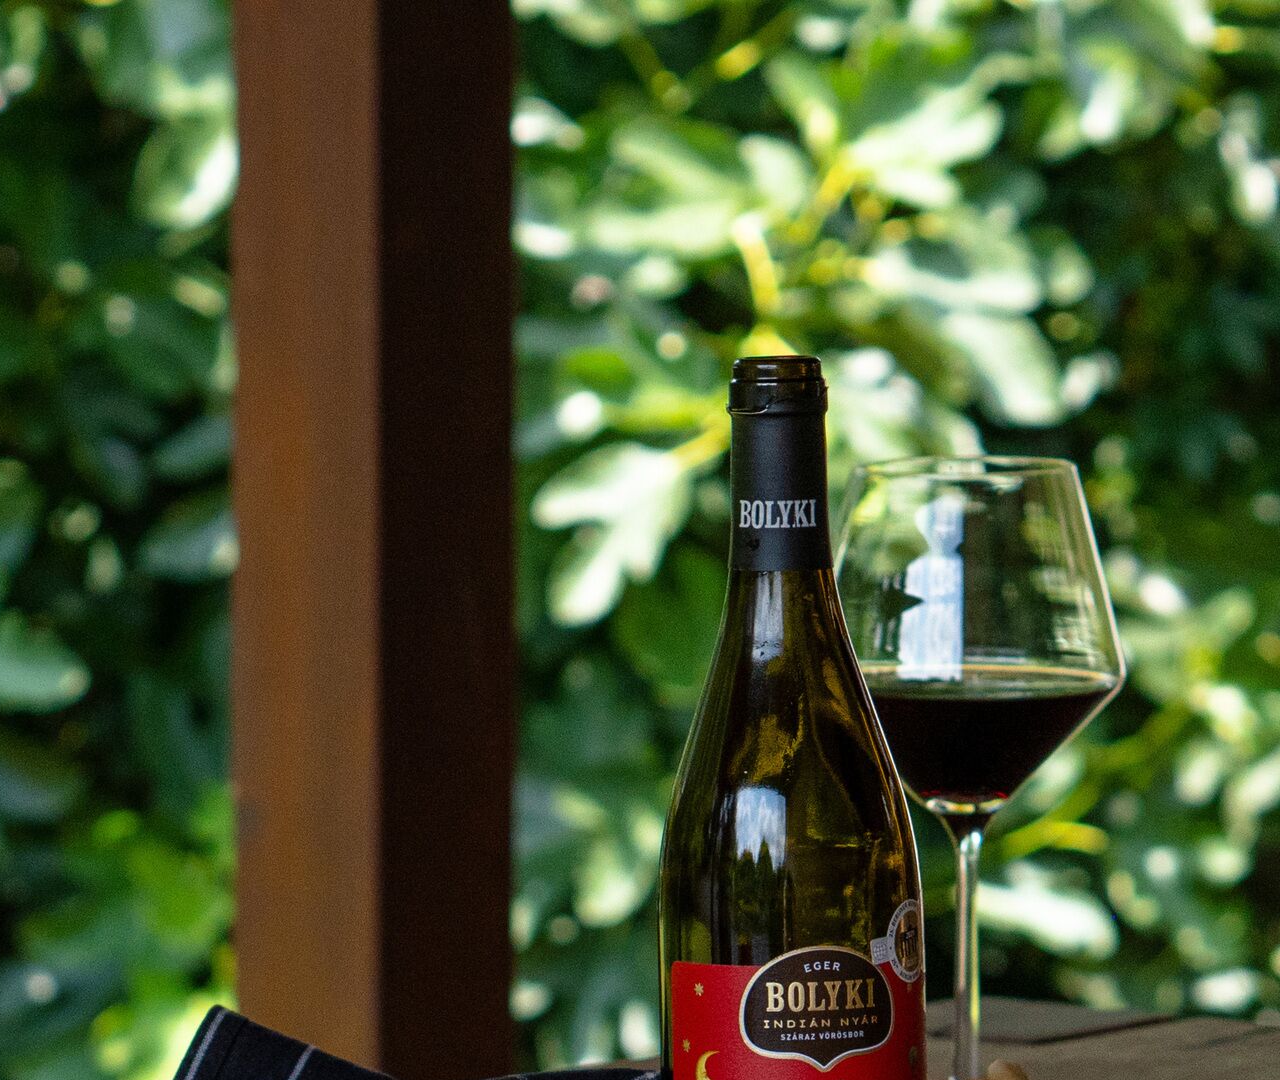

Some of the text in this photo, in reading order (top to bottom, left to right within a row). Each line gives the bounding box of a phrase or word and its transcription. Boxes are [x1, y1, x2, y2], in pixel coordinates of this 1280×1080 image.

[739, 499, 817, 528] BOLYKI
[803, 961, 840, 973] EGER
[765, 979, 875, 1013] BOLYKI
[763, 1015, 878, 1028] INDIÁN NYÁR
[780, 1030, 865, 1041] SZÁRAZ VÖRÖSBOR
